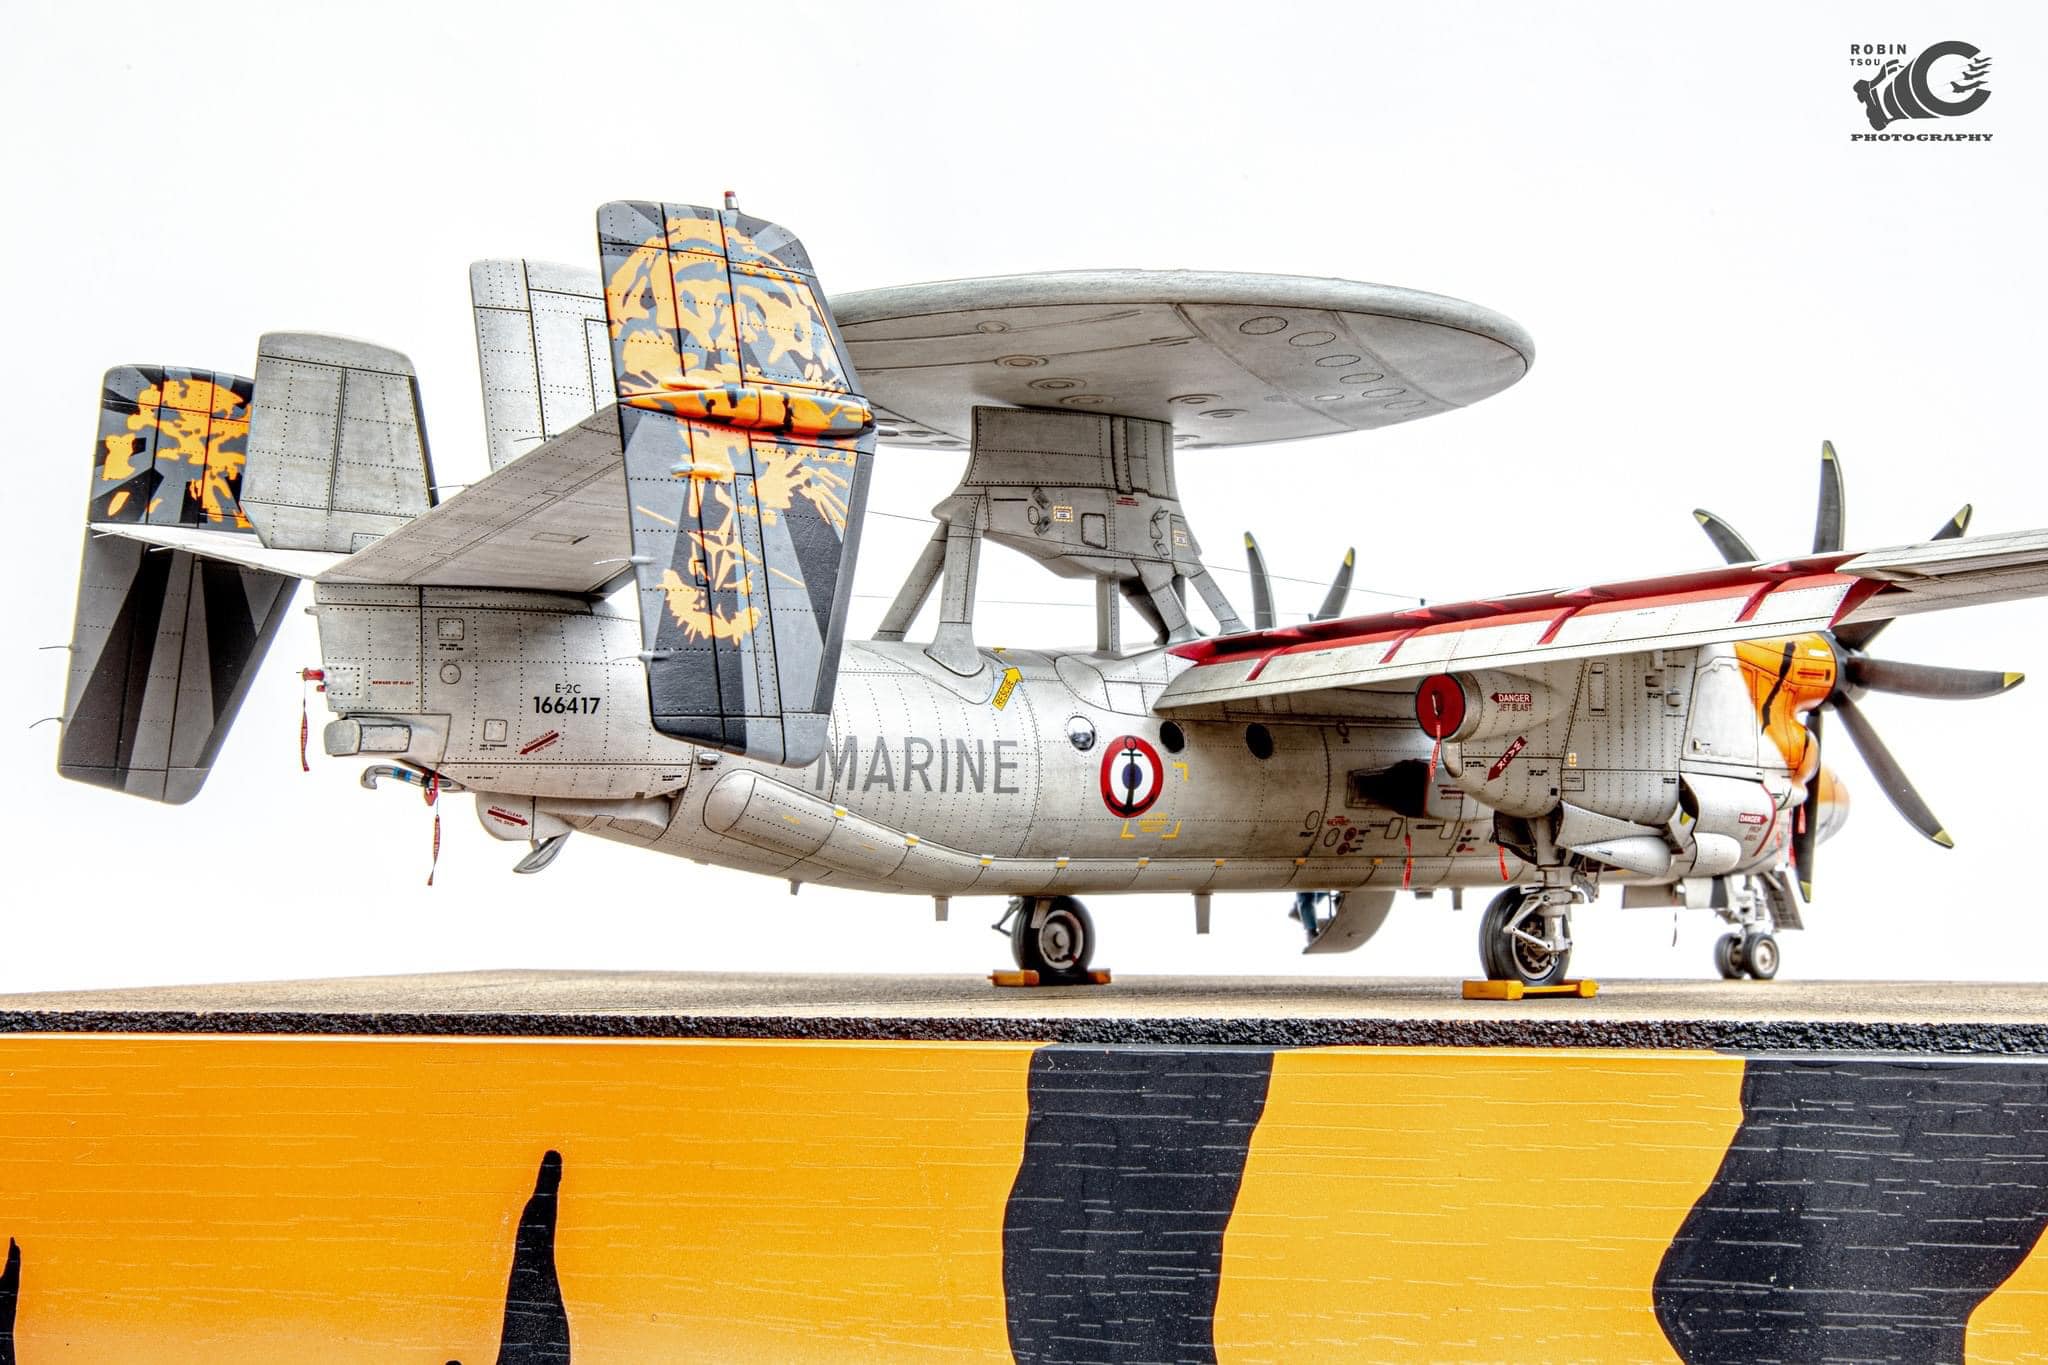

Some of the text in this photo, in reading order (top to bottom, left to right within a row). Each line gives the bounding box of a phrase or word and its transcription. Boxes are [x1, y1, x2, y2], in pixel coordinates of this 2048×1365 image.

[554, 683, 582, 694] E-2C
[995, 678, 1014, 707] RESCUE
[1498, 693, 1531, 702] DANGER
[533, 696, 601, 714] 166417
[1499, 703, 1532, 711] JET BLAST
[815, 735, 1020, 793] MARINE
[1497, 741, 1522, 770] WALK
